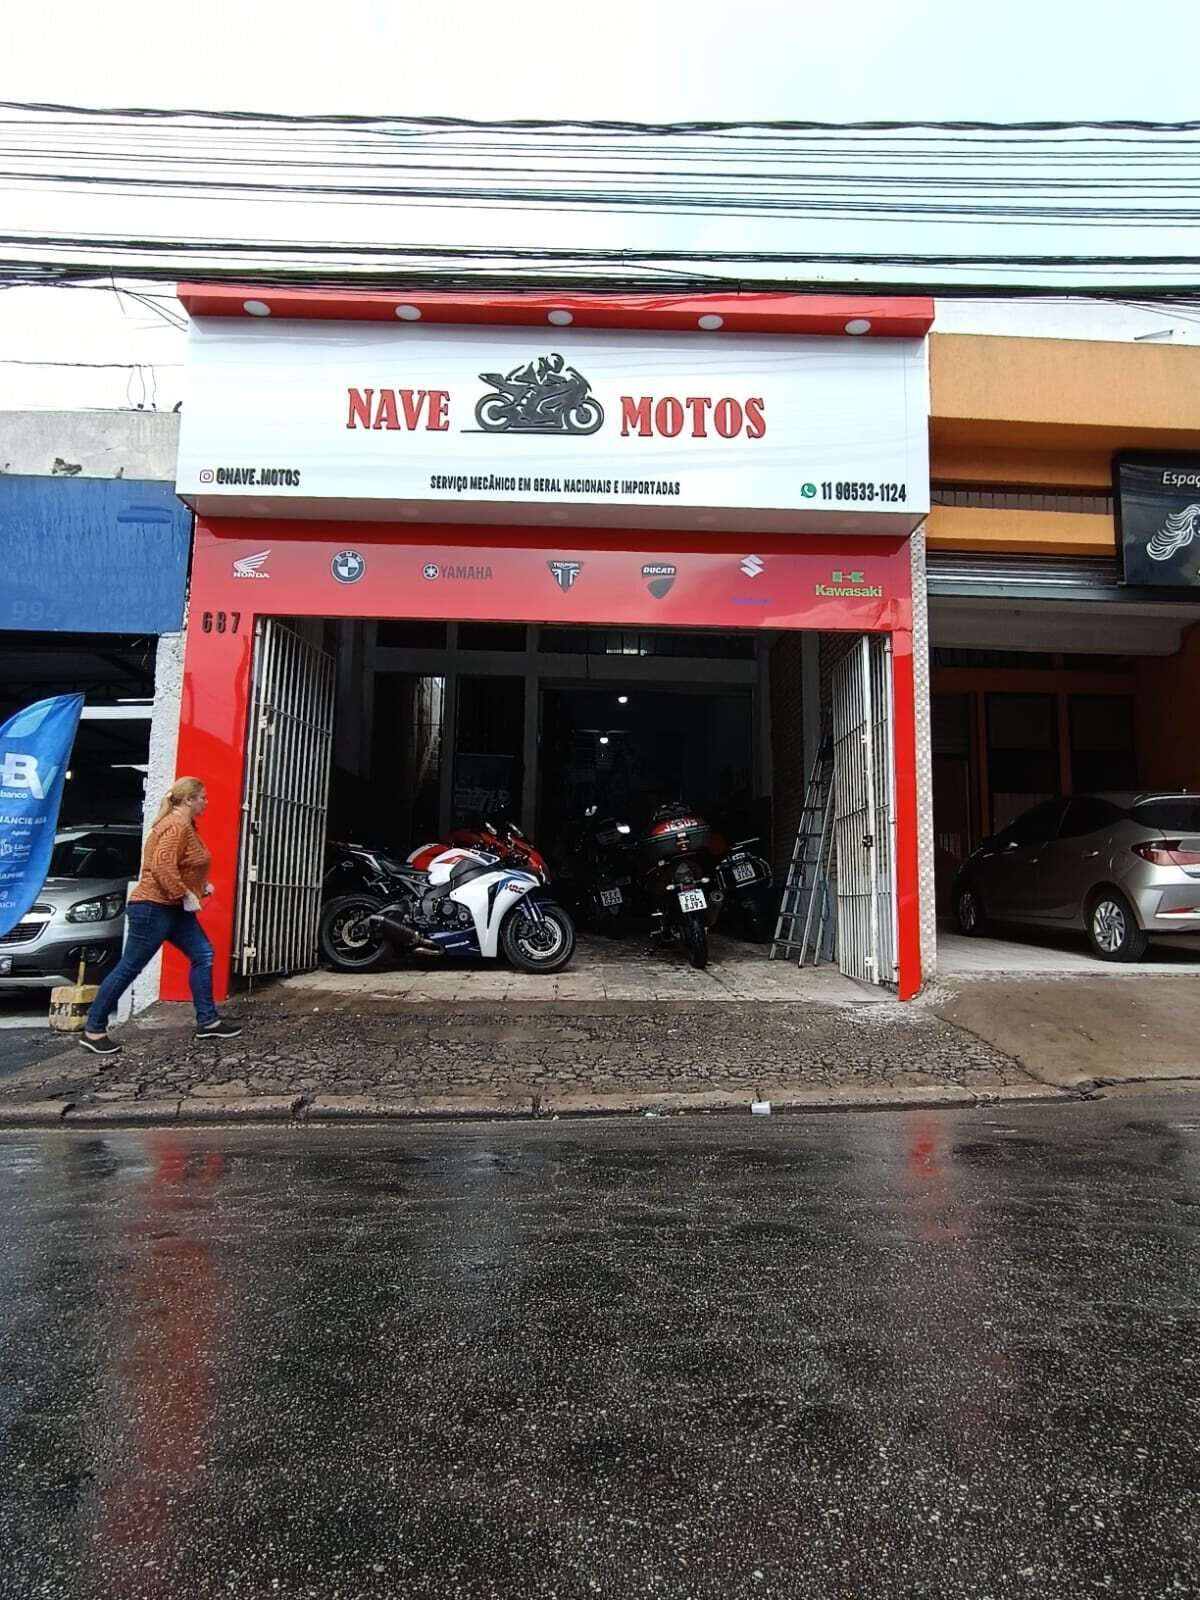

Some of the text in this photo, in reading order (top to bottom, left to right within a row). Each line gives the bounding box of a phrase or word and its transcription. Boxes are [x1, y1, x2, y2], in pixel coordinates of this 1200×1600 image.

[346, 388, 767, 439] NAVE MOTOS
[216, 467, 301, 487] @NAVE.MOTOS
[430, 474, 681, 496] SERVIÇO MECÂNICO EM GERAL NACIONAIS E IMPORTADAS
[821, 481, 832, 500] 11
[232, 571, 270, 579] HONDA
[440, 565, 493, 580] YAMAHA
[642, 566, 676, 575] DUCATI
[815, 584, 884, 598] Kawasaki
[202, 611, 241, 635] 687
